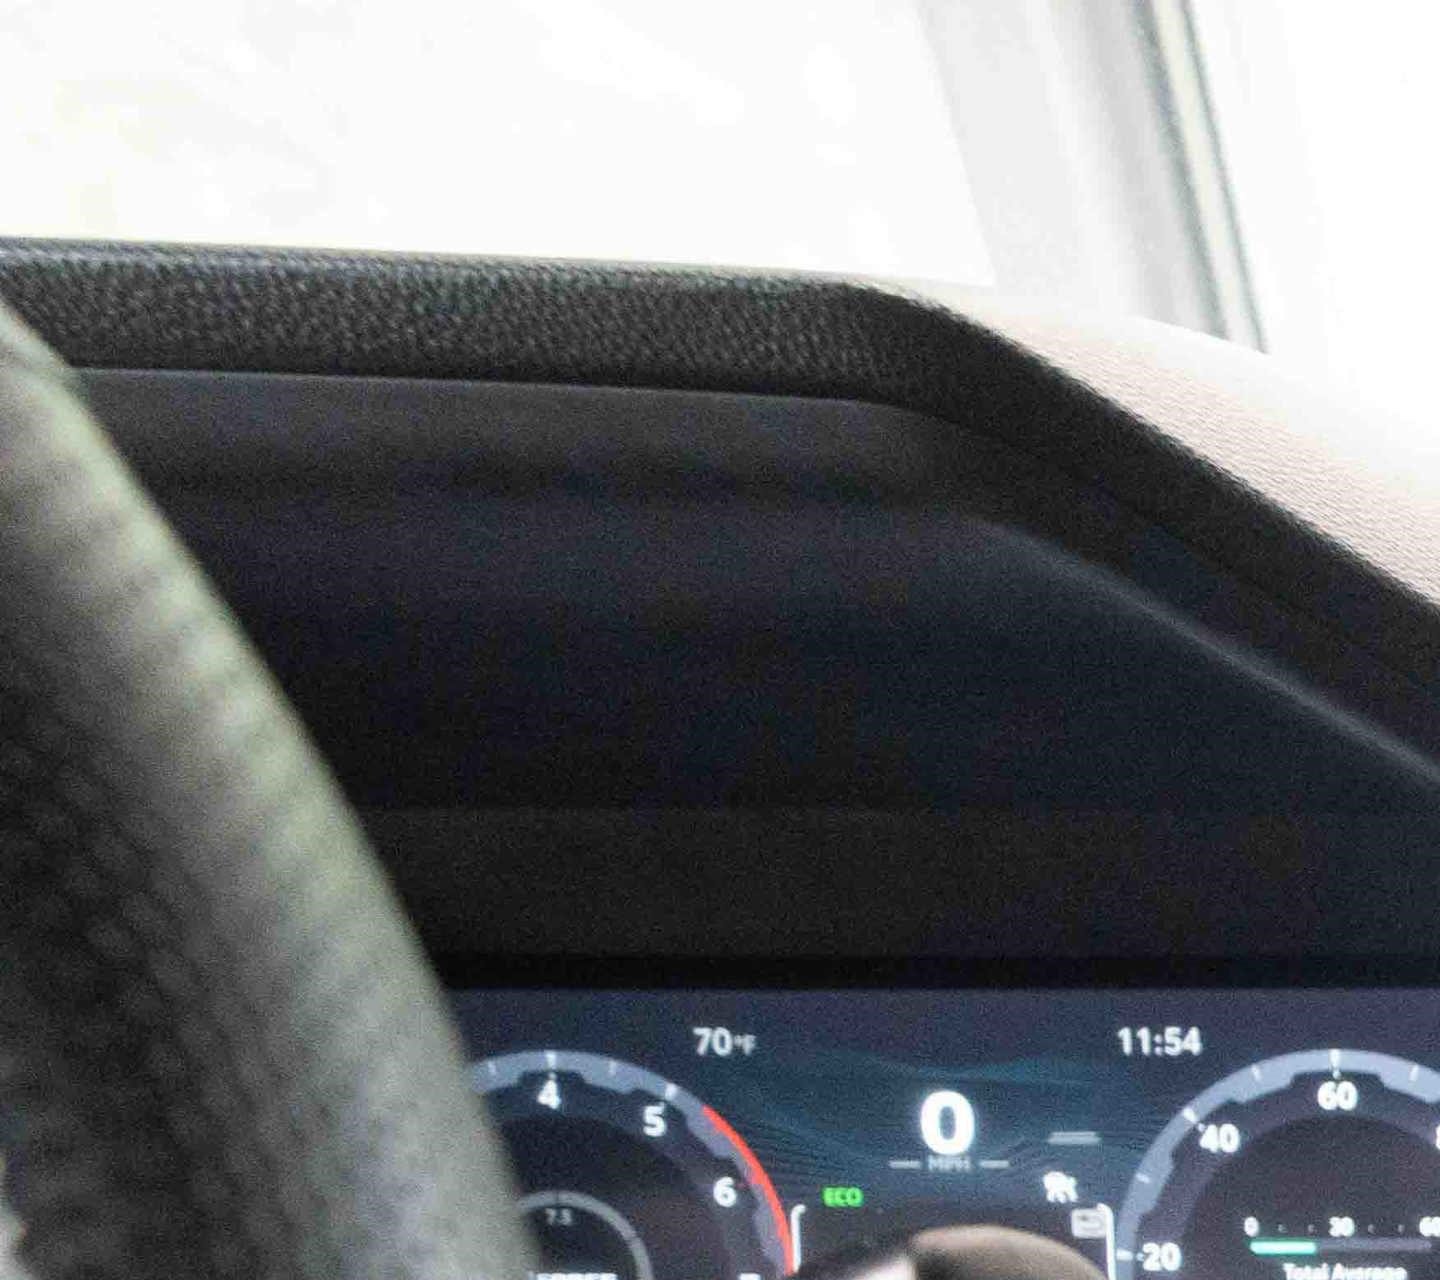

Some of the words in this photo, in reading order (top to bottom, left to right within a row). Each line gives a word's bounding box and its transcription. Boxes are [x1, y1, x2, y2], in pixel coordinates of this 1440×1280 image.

[1116, 1026, 1202, 1056] 11:54
[536, 1080, 561, 1110] 4
[1317, 1081, 1358, 1111] 60
[642, 1106, 667, 1137] 5
[920, 1090, 975, 1155] 0
[1200, 1125, 1240, 1154] 40
[713, 1176, 738, 1207] 6
[1329, 1216, 1355, 1237] 30
[1142, 1242, 1182, 1271] 20
